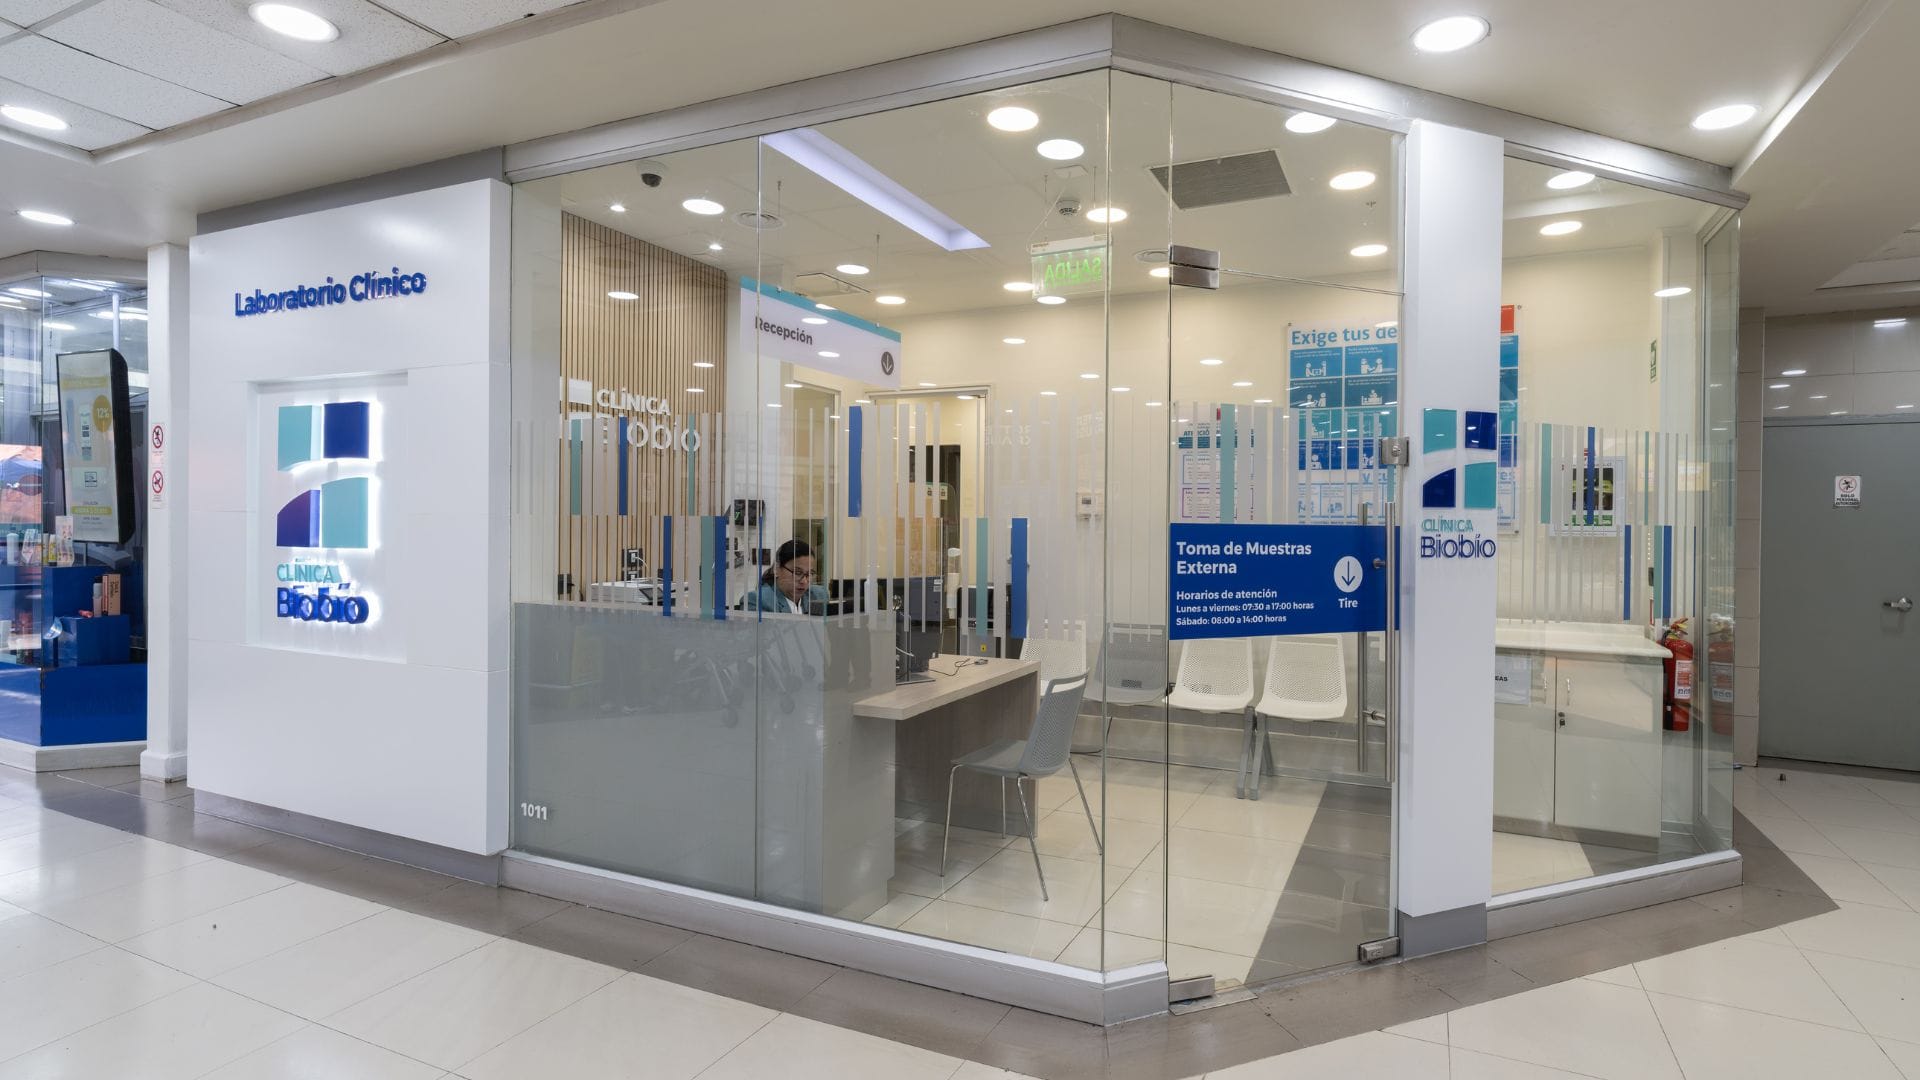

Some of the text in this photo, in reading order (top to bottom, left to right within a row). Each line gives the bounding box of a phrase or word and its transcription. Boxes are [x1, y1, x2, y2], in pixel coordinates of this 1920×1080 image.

[235, 267, 427, 316] Laboratorio Clínico
[755, 316, 813, 345] Recepción
[1291, 329, 1338, 347] Exige
[1342, 328, 1370, 342] tus
[597, 387, 671, 416] CLÍNICA
[1421, 515, 1474, 532] CLÍNICA
[1176, 541, 1312, 556] Toma de Muestras
[1420, 533, 1497, 558] Biobío
[276, 558, 342, 584] CLÍNICA
[1176, 560, 1237, 575] Externa
[277, 583, 370, 624] Biobío
[1176, 588, 1278, 600] Horarios de atención
[1338, 598, 1359, 608] Tire
[1176, 604, 1201, 613] Lunes
[1209, 603, 1241, 612] viernes:
[1242, 602, 1265, 611] 07:30
[1271, 602, 1292, 610] 17:00
[1292, 601, 1315, 609] horas
[1176, 617, 1211, 626] Sábado:
[1211, 616, 1236, 625] 08:00
[1242, 615, 1264, 624] 14:00
[1264, 614, 1287, 623] horas
[520, 802, 548, 821] 1011
